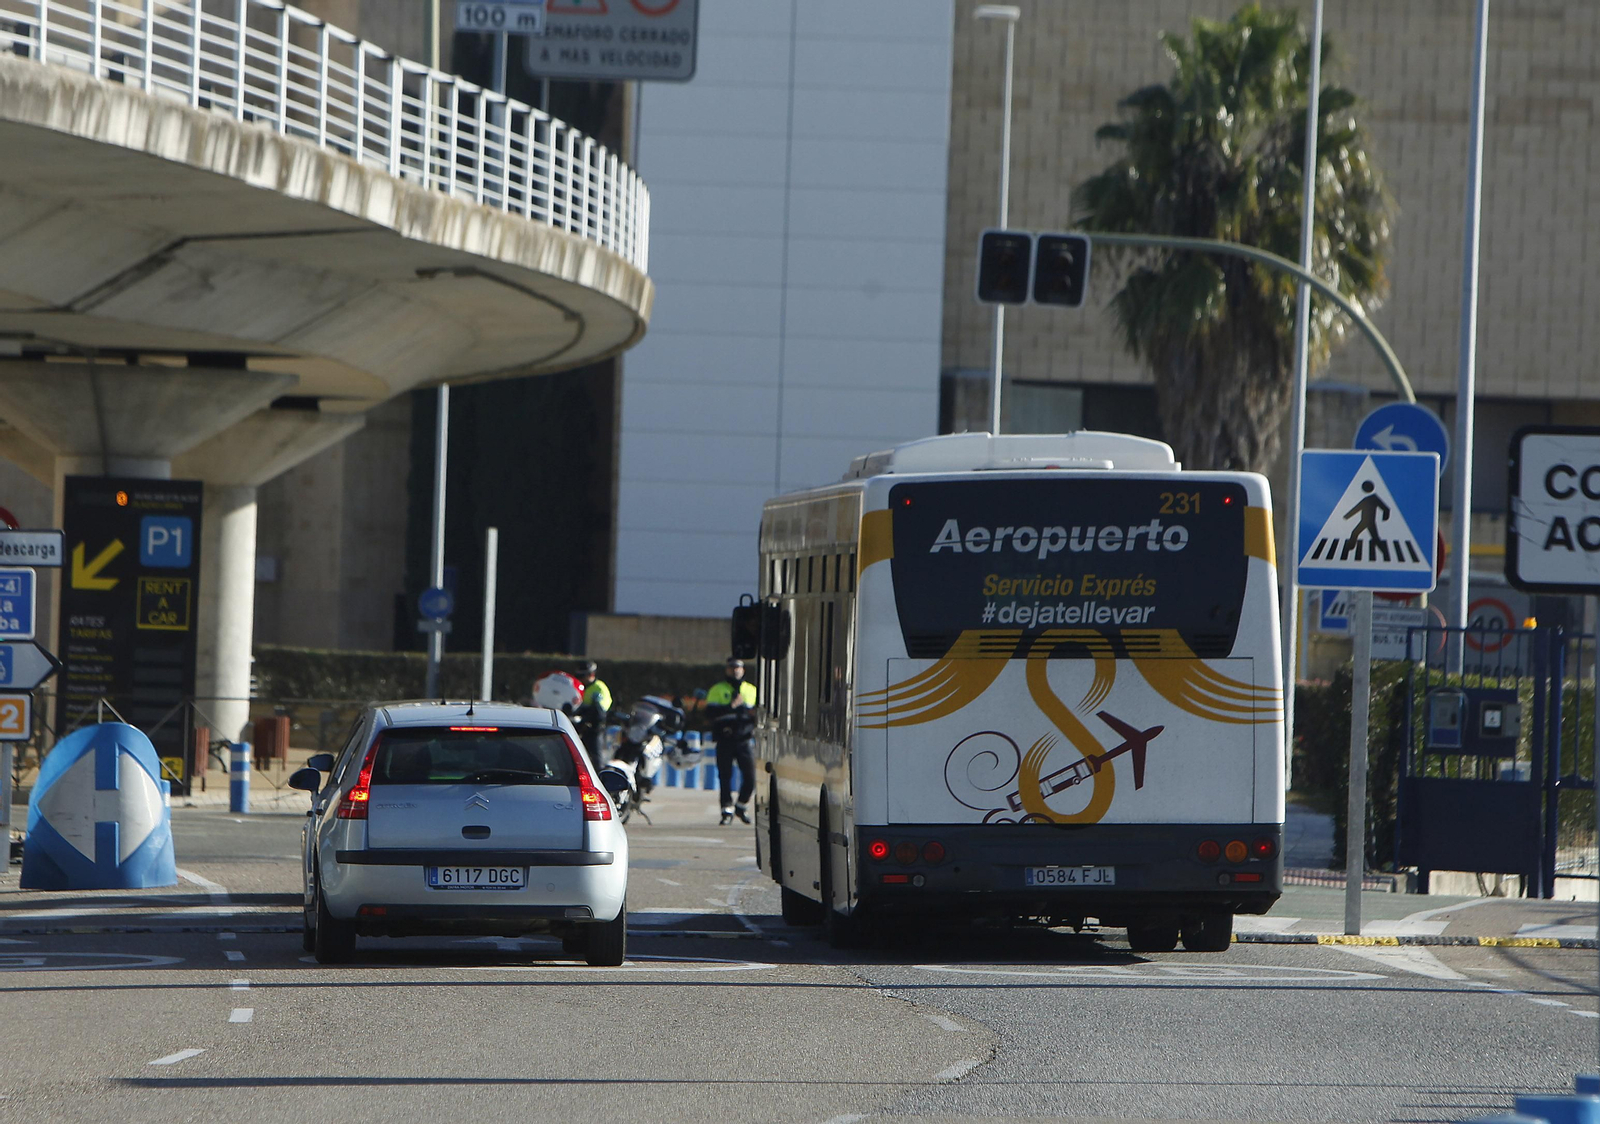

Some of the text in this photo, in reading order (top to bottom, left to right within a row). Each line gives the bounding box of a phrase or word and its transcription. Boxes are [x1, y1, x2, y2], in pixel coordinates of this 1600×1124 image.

[465, 5, 536, 29] 100 m
[545, 25, 691, 46] EMAFORO CERRADO
[540, 46, 683, 68] A MAS VELOCIDAD
[1158, 492, 1202, 515] 231
[147, 526, 182, 557] P1
[930, 518, 1190, 560] Aeropuerto
[145, 580, 183, 595] RENT
[982, 574, 1157, 601] Servicio Exprés
[157, 596, 169, 610] A
[147, 610, 178, 625] CAR
[982, 601, 1156, 629] #dejatellevar
[443, 868, 520, 884] 6117 DGC
[1036, 869, 1112, 884] 0584 FJL
